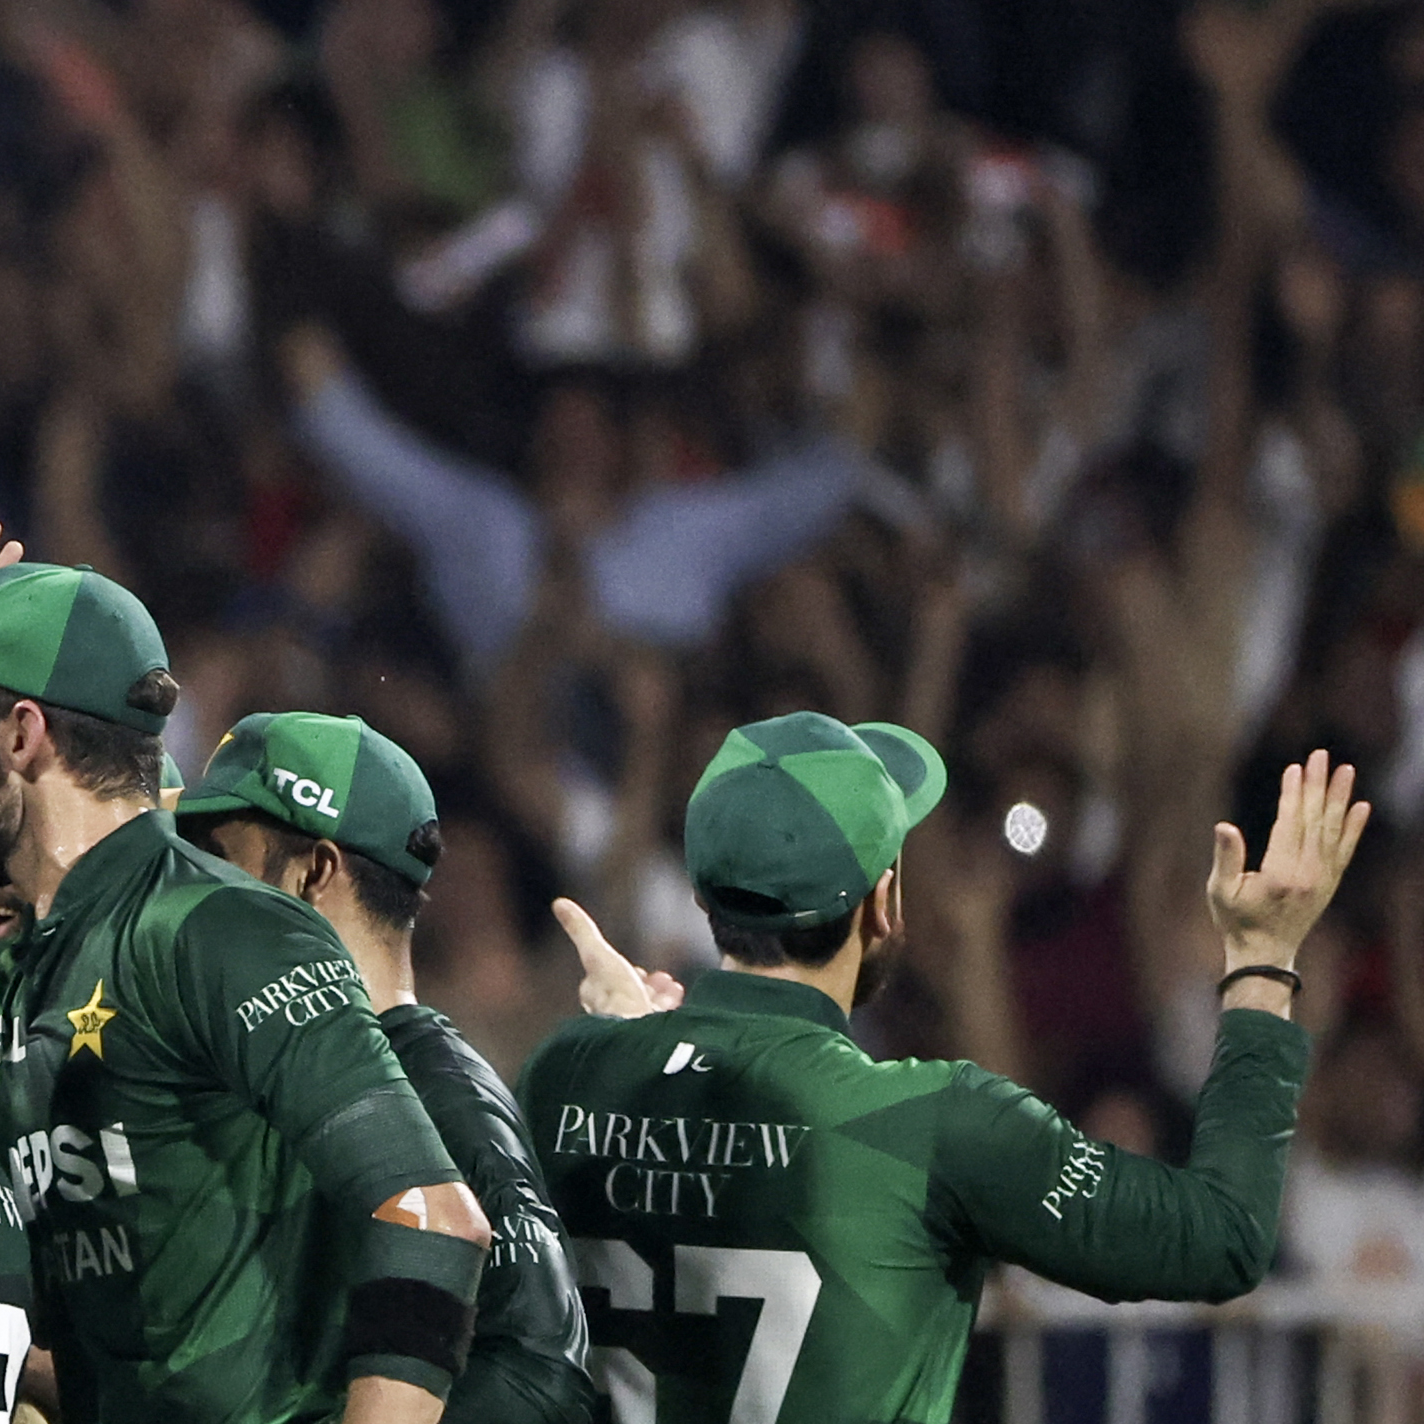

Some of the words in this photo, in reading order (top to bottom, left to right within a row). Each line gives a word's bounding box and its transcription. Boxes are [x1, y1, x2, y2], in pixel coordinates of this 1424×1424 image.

[273, 767, 340, 819] TCL
[285, 981, 351, 1027] CITY
[553, 1104, 813, 1169] PARKVIEW
[604, 1162, 733, 1218] CITY
